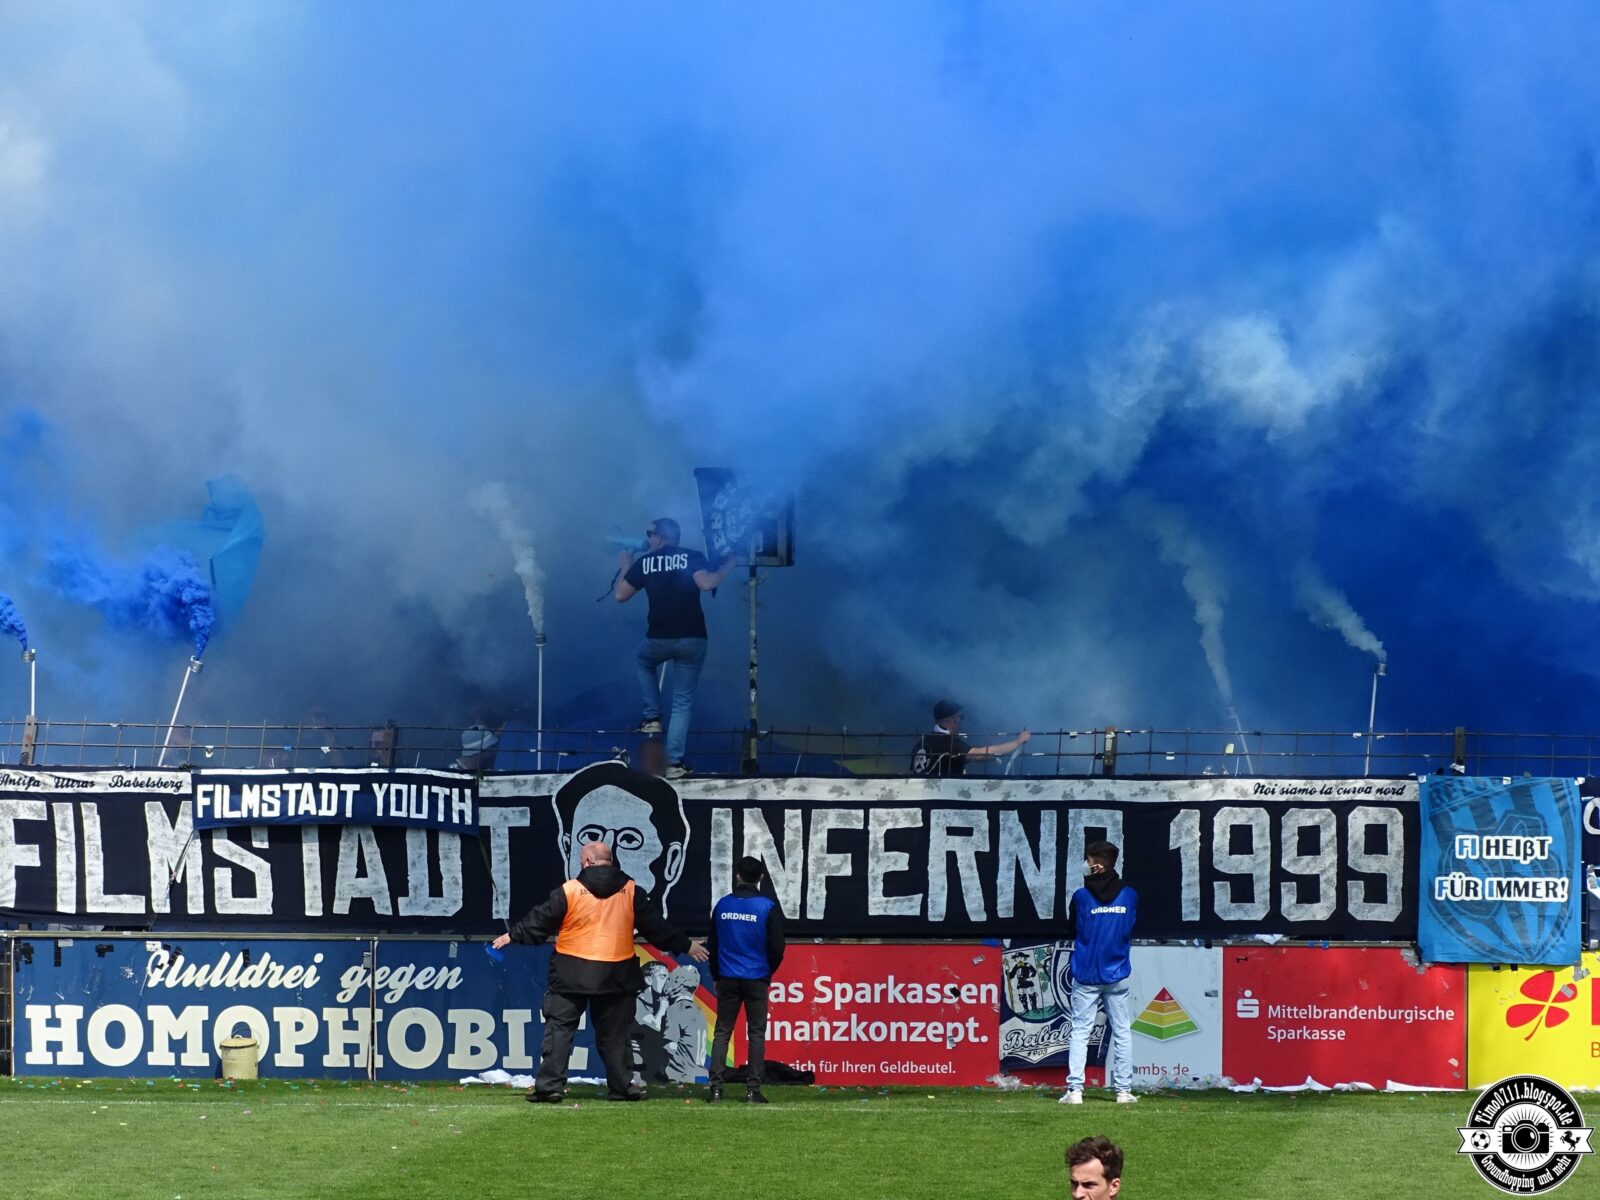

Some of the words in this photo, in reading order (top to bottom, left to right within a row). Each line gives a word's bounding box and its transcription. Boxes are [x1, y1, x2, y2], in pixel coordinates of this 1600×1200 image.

[642, 553, 689, 575] ULTRAS
[0, 775, 41, 790] Antifa
[53, 776, 95, 788] Ultras
[108, 775, 184, 792] Babelsberg
[1253, 783, 1276, 796] Noi
[1279, 784, 1317, 796] siamo
[1319, 784, 1333, 795] la
[1337, 786, 1373, 796] curva
[1376, 784, 1406, 796] nord
[197, 782, 360, 818] FILMSTADT
[372, 783, 472, 825] YOUTH
[1458, 837, 1477, 857] FI
[0, 799, 531, 920] FILMSTADT
[1168, 806, 1404, 922] 1999
[1437, 874, 1480, 898] FÜR
[1488, 879, 1567, 898] IMMER!
[721, 912, 757, 922] ORDNER
[336, 962, 463, 1003] gegen
[769, 982, 804, 1003] as
[814, 975, 998, 1011] Sparkassen
[1268, 1005, 1455, 1023] Mittelbrandenburgische
[746, 1013, 989, 1049] inanzkonzept.
[1267, 1026, 1346, 1042] Sparkasse
[819, 1060, 838, 1073] für
[842, 1061, 876, 1073] Ihren
[880, 1061, 956, 1074] Geldbeutel.
